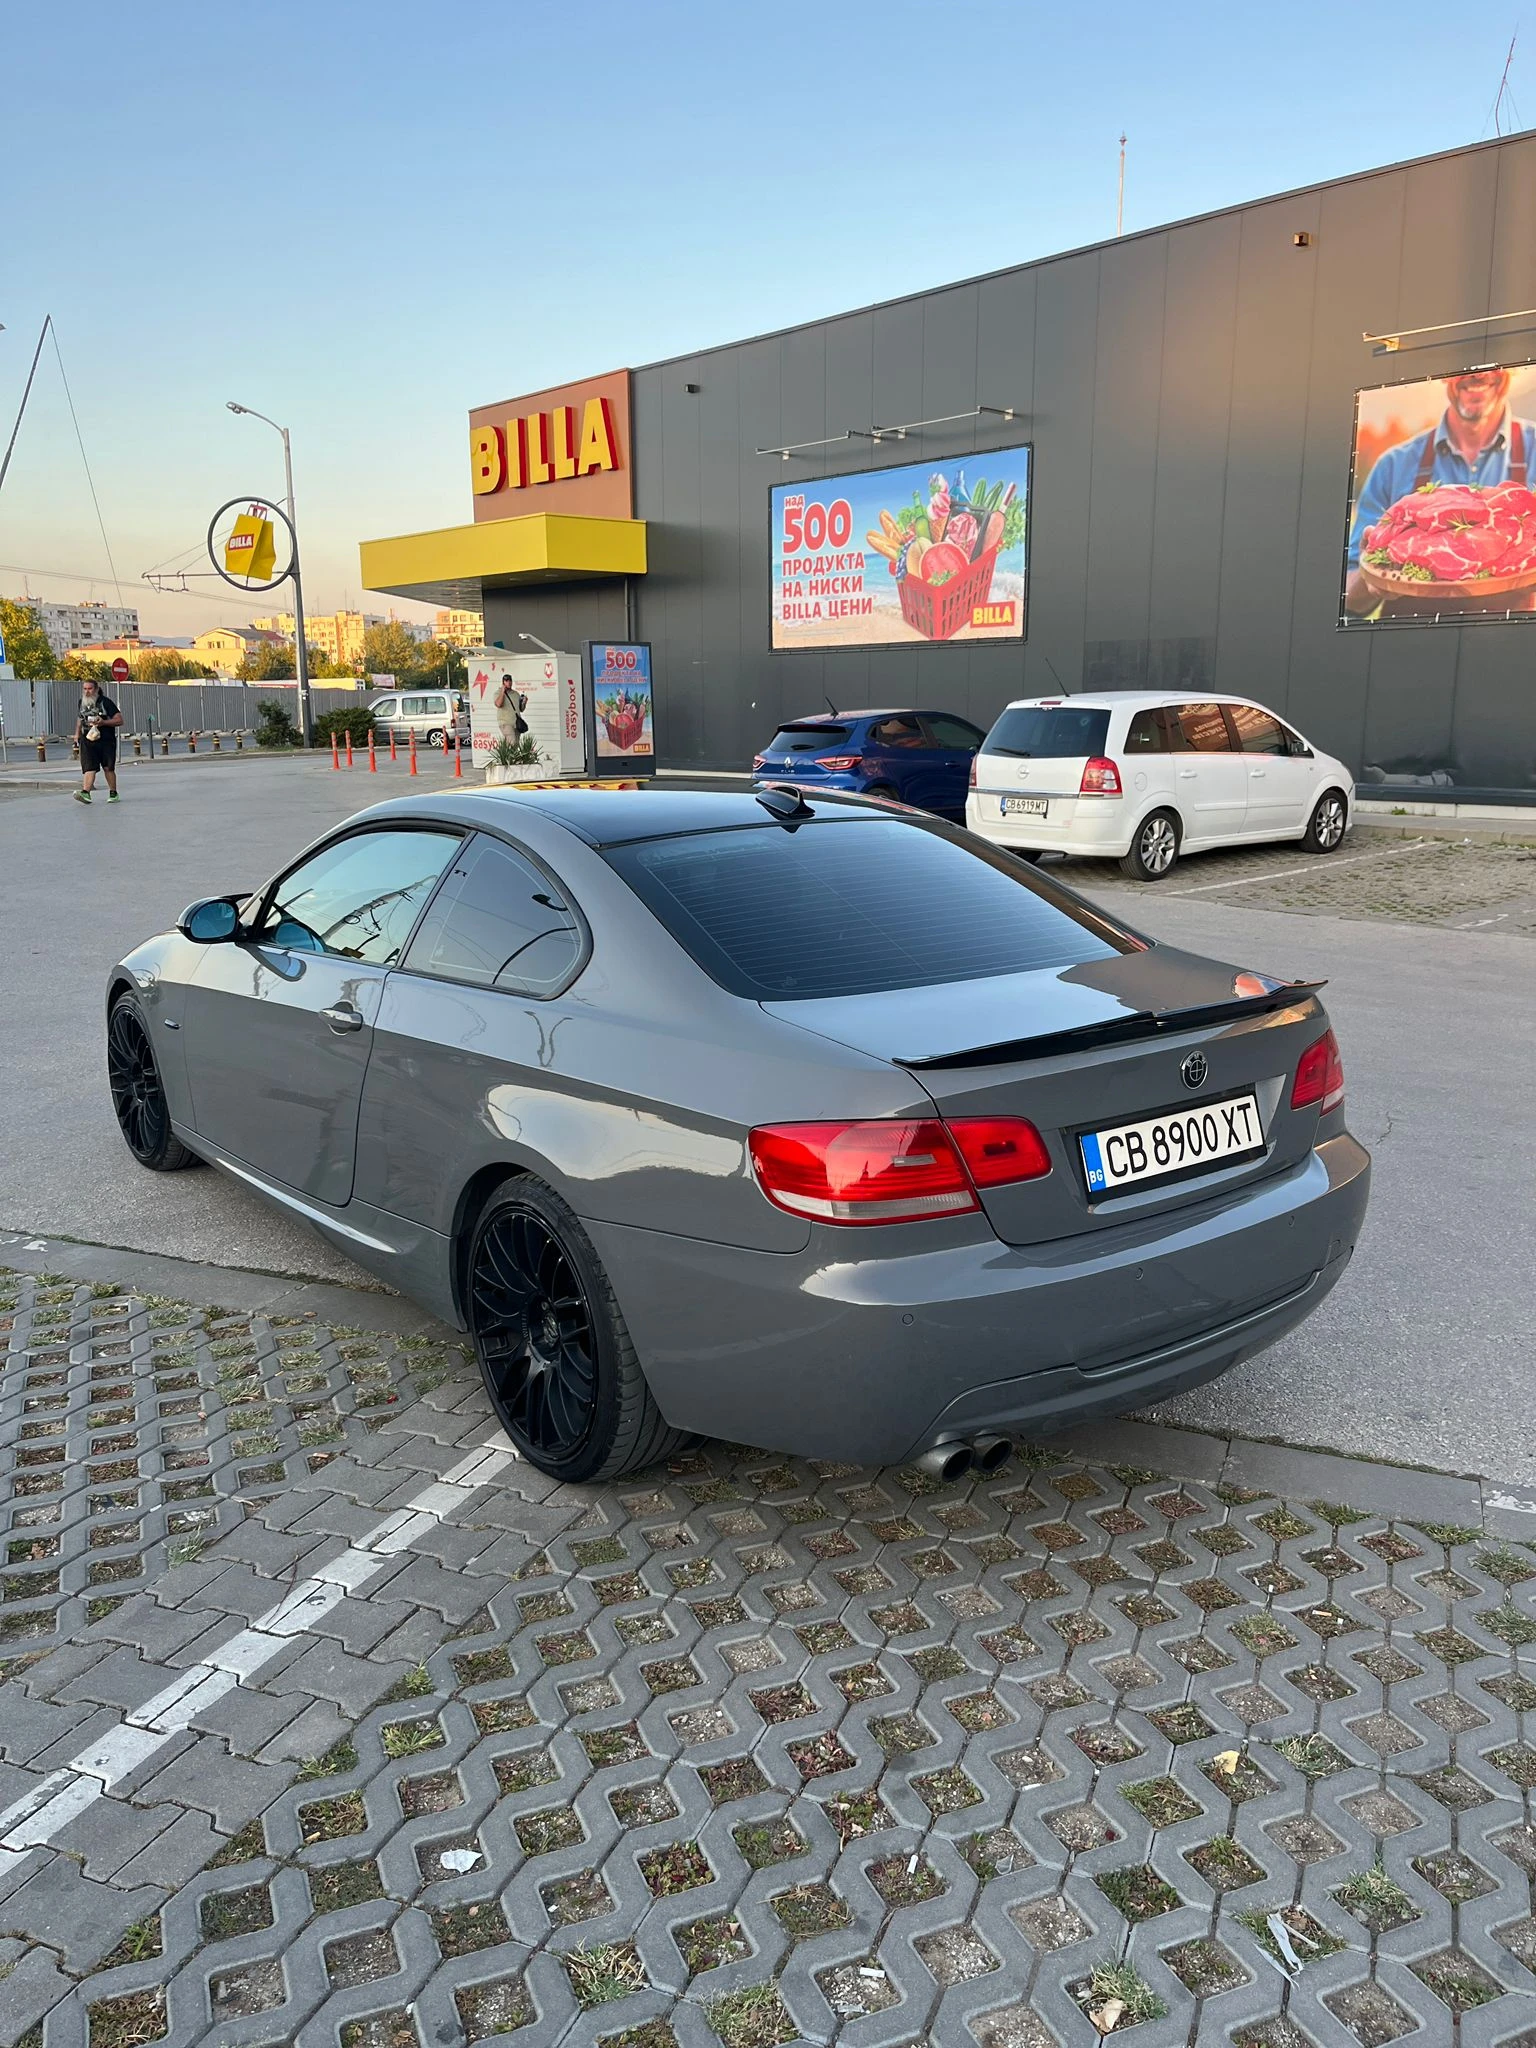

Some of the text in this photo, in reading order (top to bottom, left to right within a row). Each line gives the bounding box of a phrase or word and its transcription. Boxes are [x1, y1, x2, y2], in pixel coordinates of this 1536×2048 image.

[471, 397, 619, 496] BILLA
[784, 495, 805, 507] над
[783, 499, 852, 554] 500
[229, 535, 253, 549] BILLA
[783, 552, 865, 576] ПРОДУКТА
[783, 575, 862, 598] НА НИСКИ
[783, 597, 873, 620] BILLA ЦЕНИ
[972, 604, 1013, 626] BILLA
[606, 651, 637, 669] 500
[568, 687, 578, 738] easybox
[1006, 799, 1015, 809] CB
[1016, 800, 1034, 810] 6919
[1106, 1103, 1251, 1178] CB 8900 XT
[1089, 1169, 1103, 1183] BG
